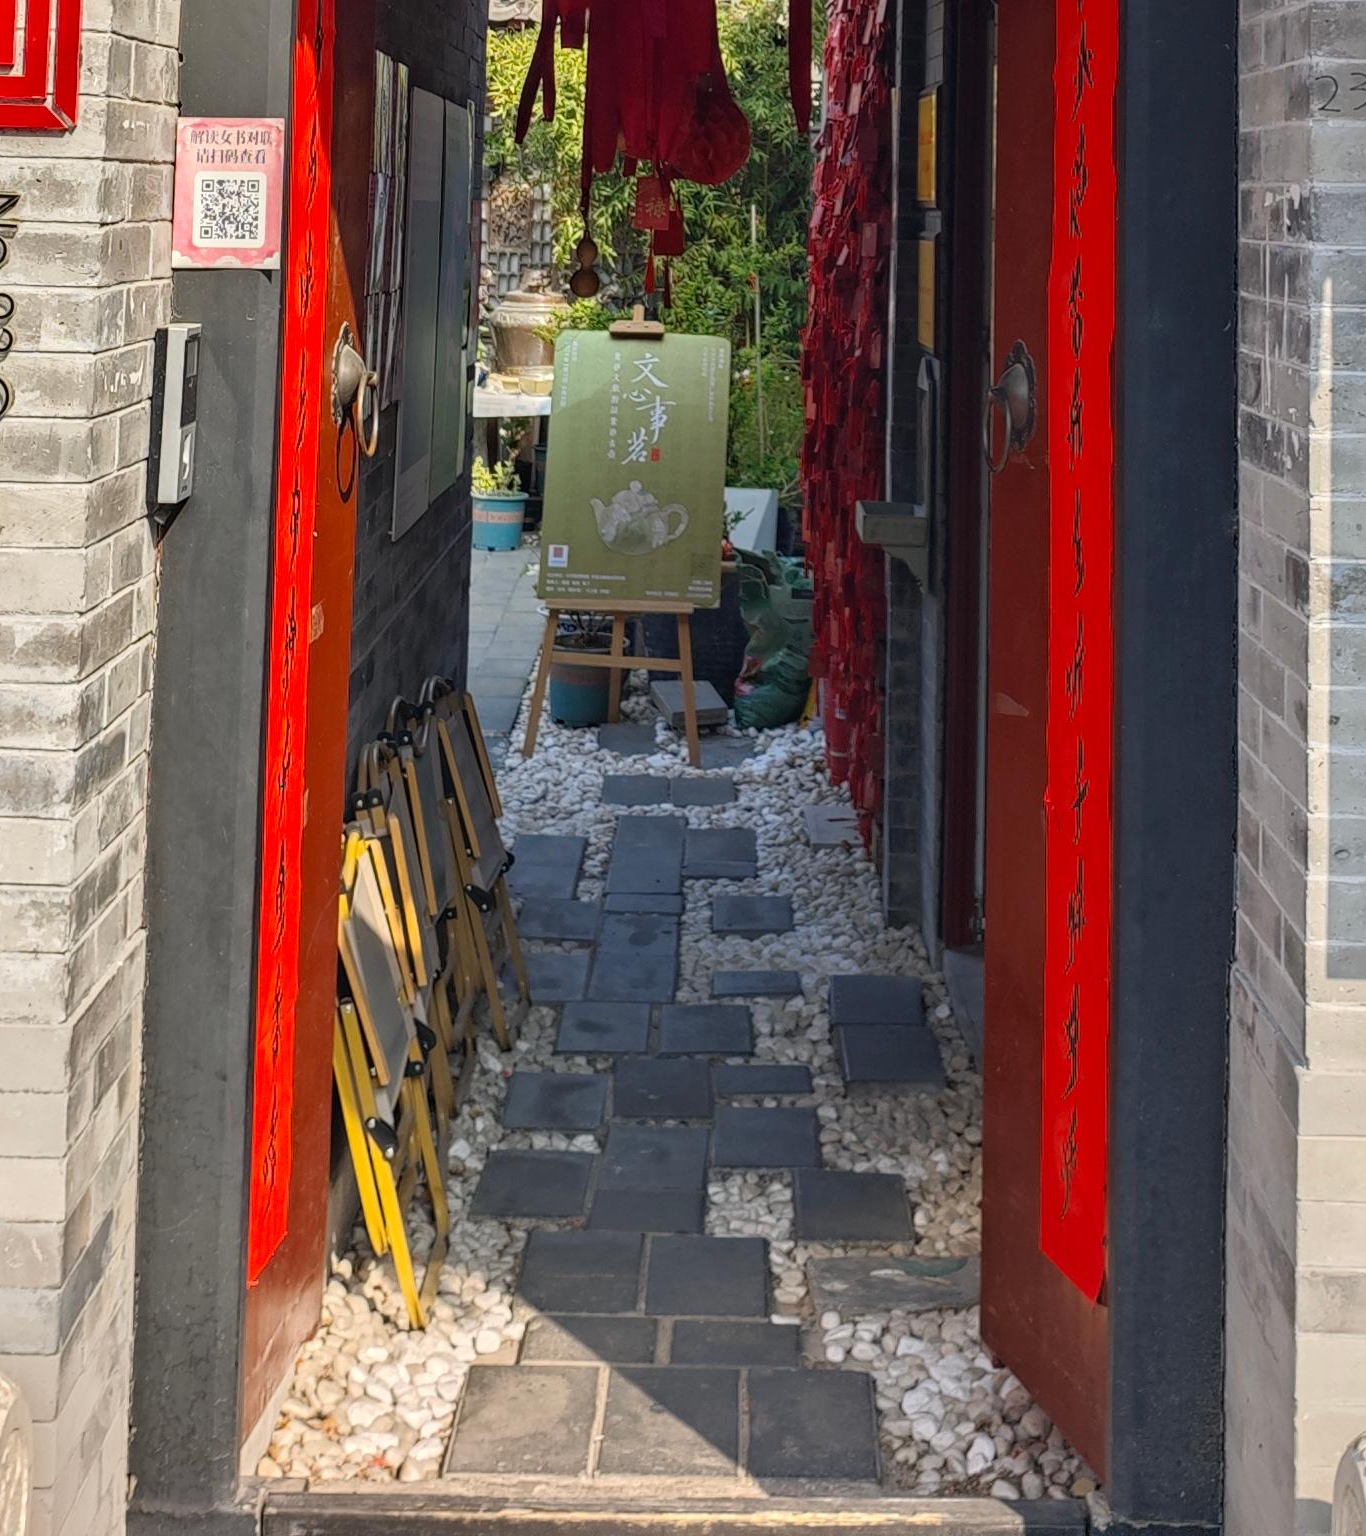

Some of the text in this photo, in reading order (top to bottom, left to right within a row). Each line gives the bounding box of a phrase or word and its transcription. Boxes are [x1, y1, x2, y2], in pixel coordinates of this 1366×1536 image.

[196, 148, 266, 164] 请扫码查看
